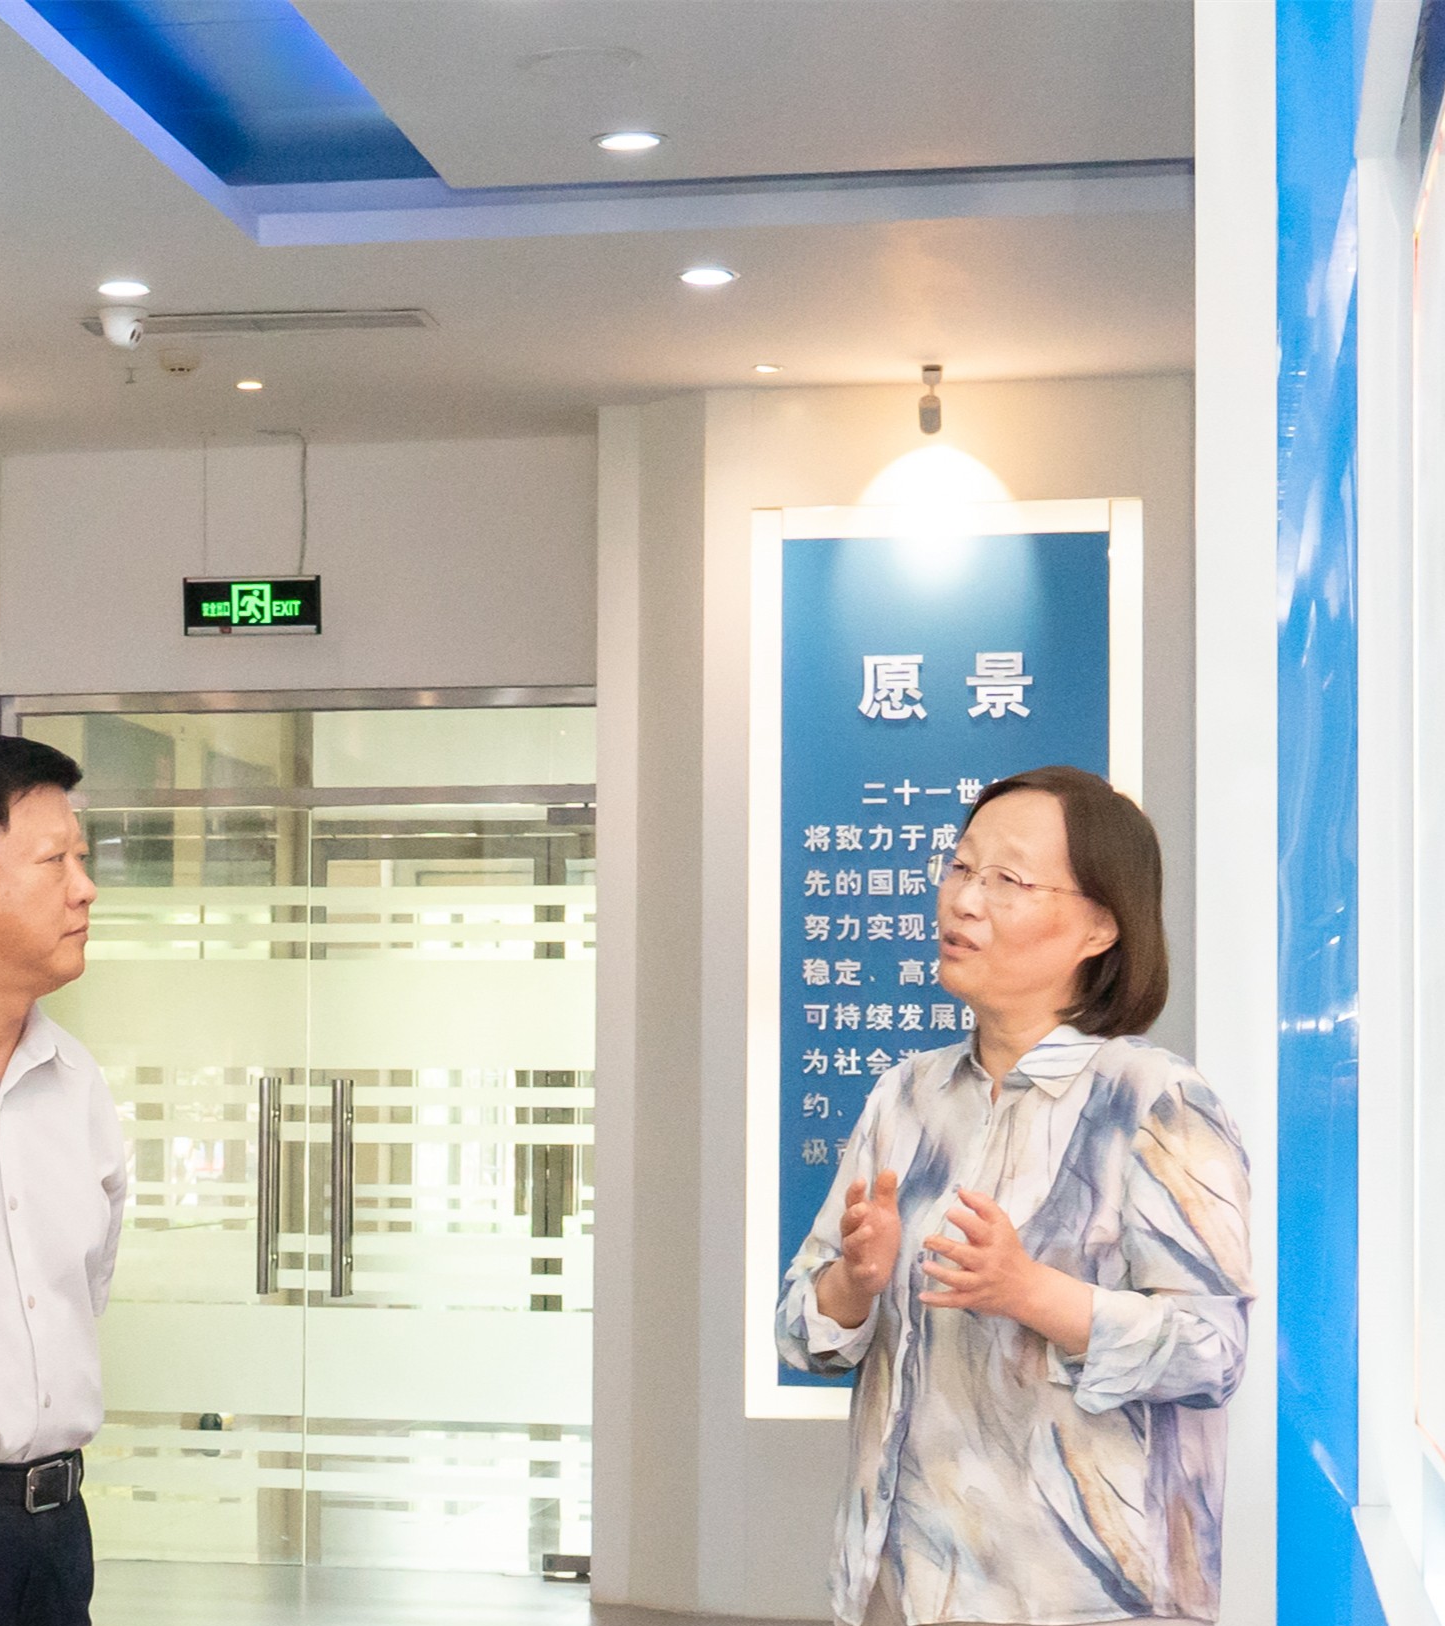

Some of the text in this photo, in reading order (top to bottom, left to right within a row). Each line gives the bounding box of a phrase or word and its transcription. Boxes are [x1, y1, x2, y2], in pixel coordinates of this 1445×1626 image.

[272, 600, 301, 616] EXIT
[857, 651, 1033, 720] 愿景
[862, 778, 1005, 806] 二十一世
[804, 824, 959, 852] 将致力于成
[804, 870, 927, 897] 先的国际
[803, 1093, 872, 1119] 约、
